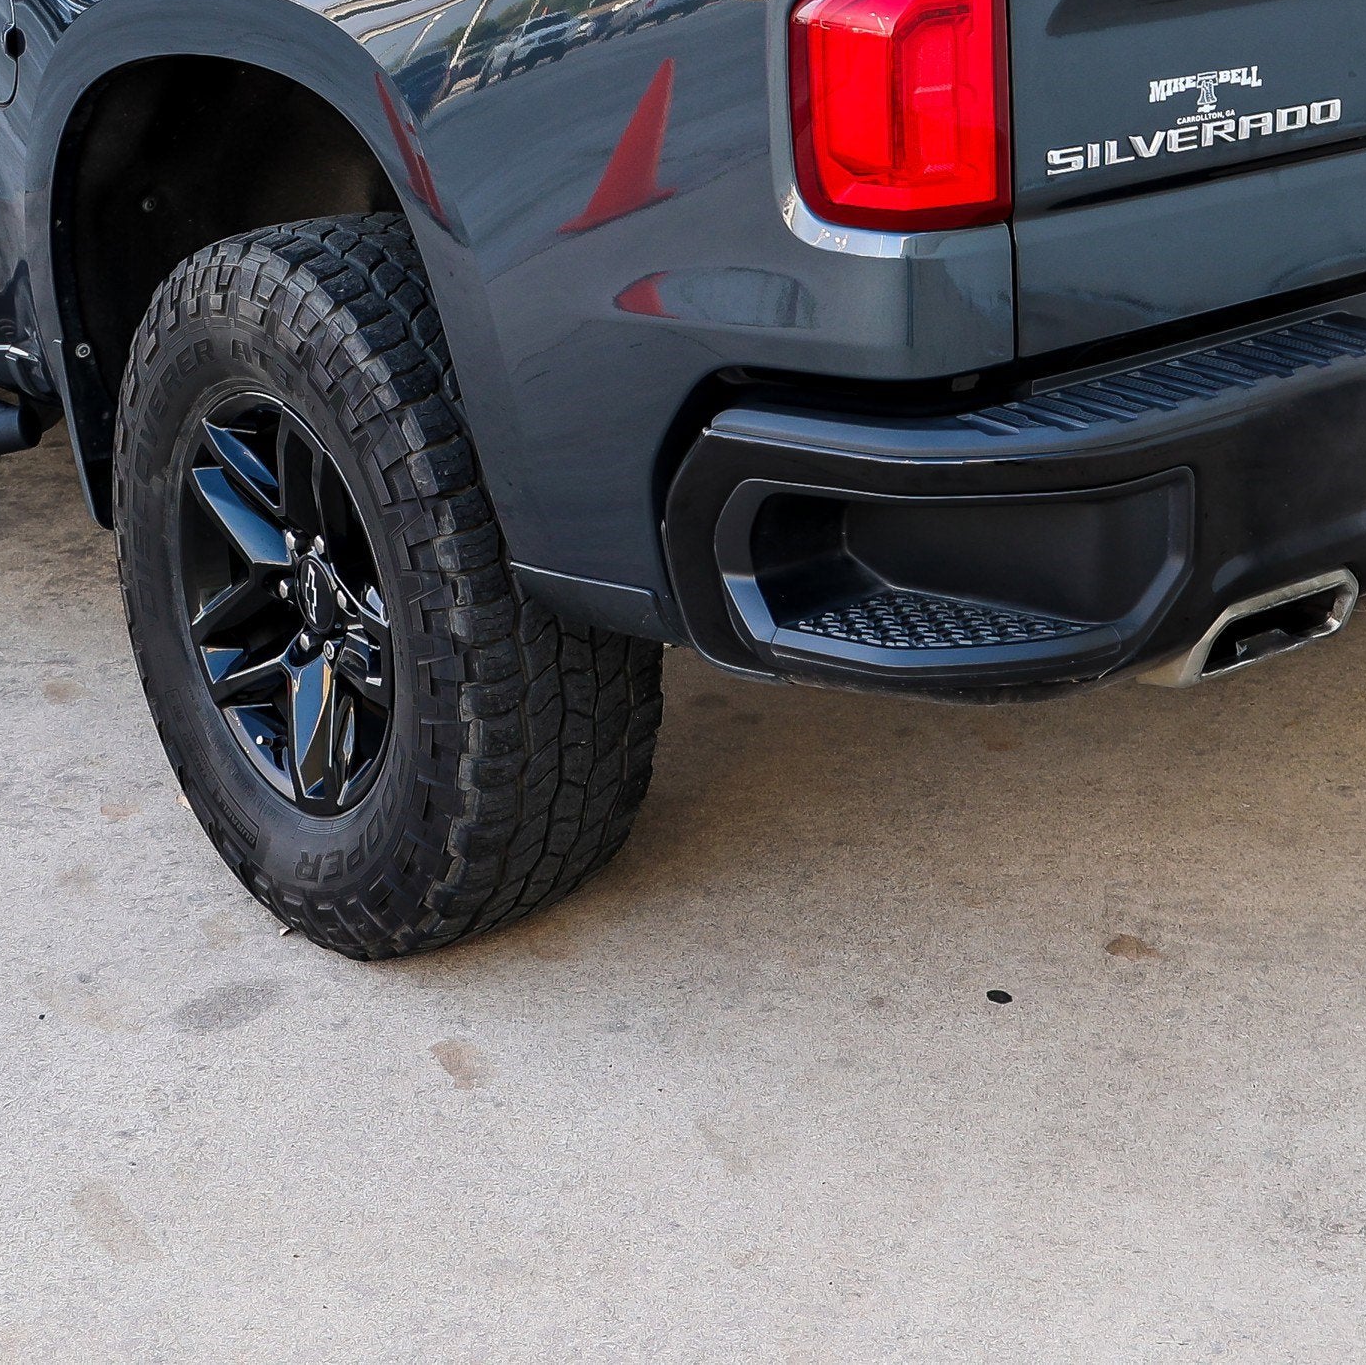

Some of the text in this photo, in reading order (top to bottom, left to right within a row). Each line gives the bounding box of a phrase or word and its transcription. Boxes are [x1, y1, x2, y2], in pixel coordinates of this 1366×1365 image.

[1148, 65, 1263, 103] MIKE BELL
[1224, 109, 1236, 117] GA
[1046, 98, 1342, 176] SILVERADO
